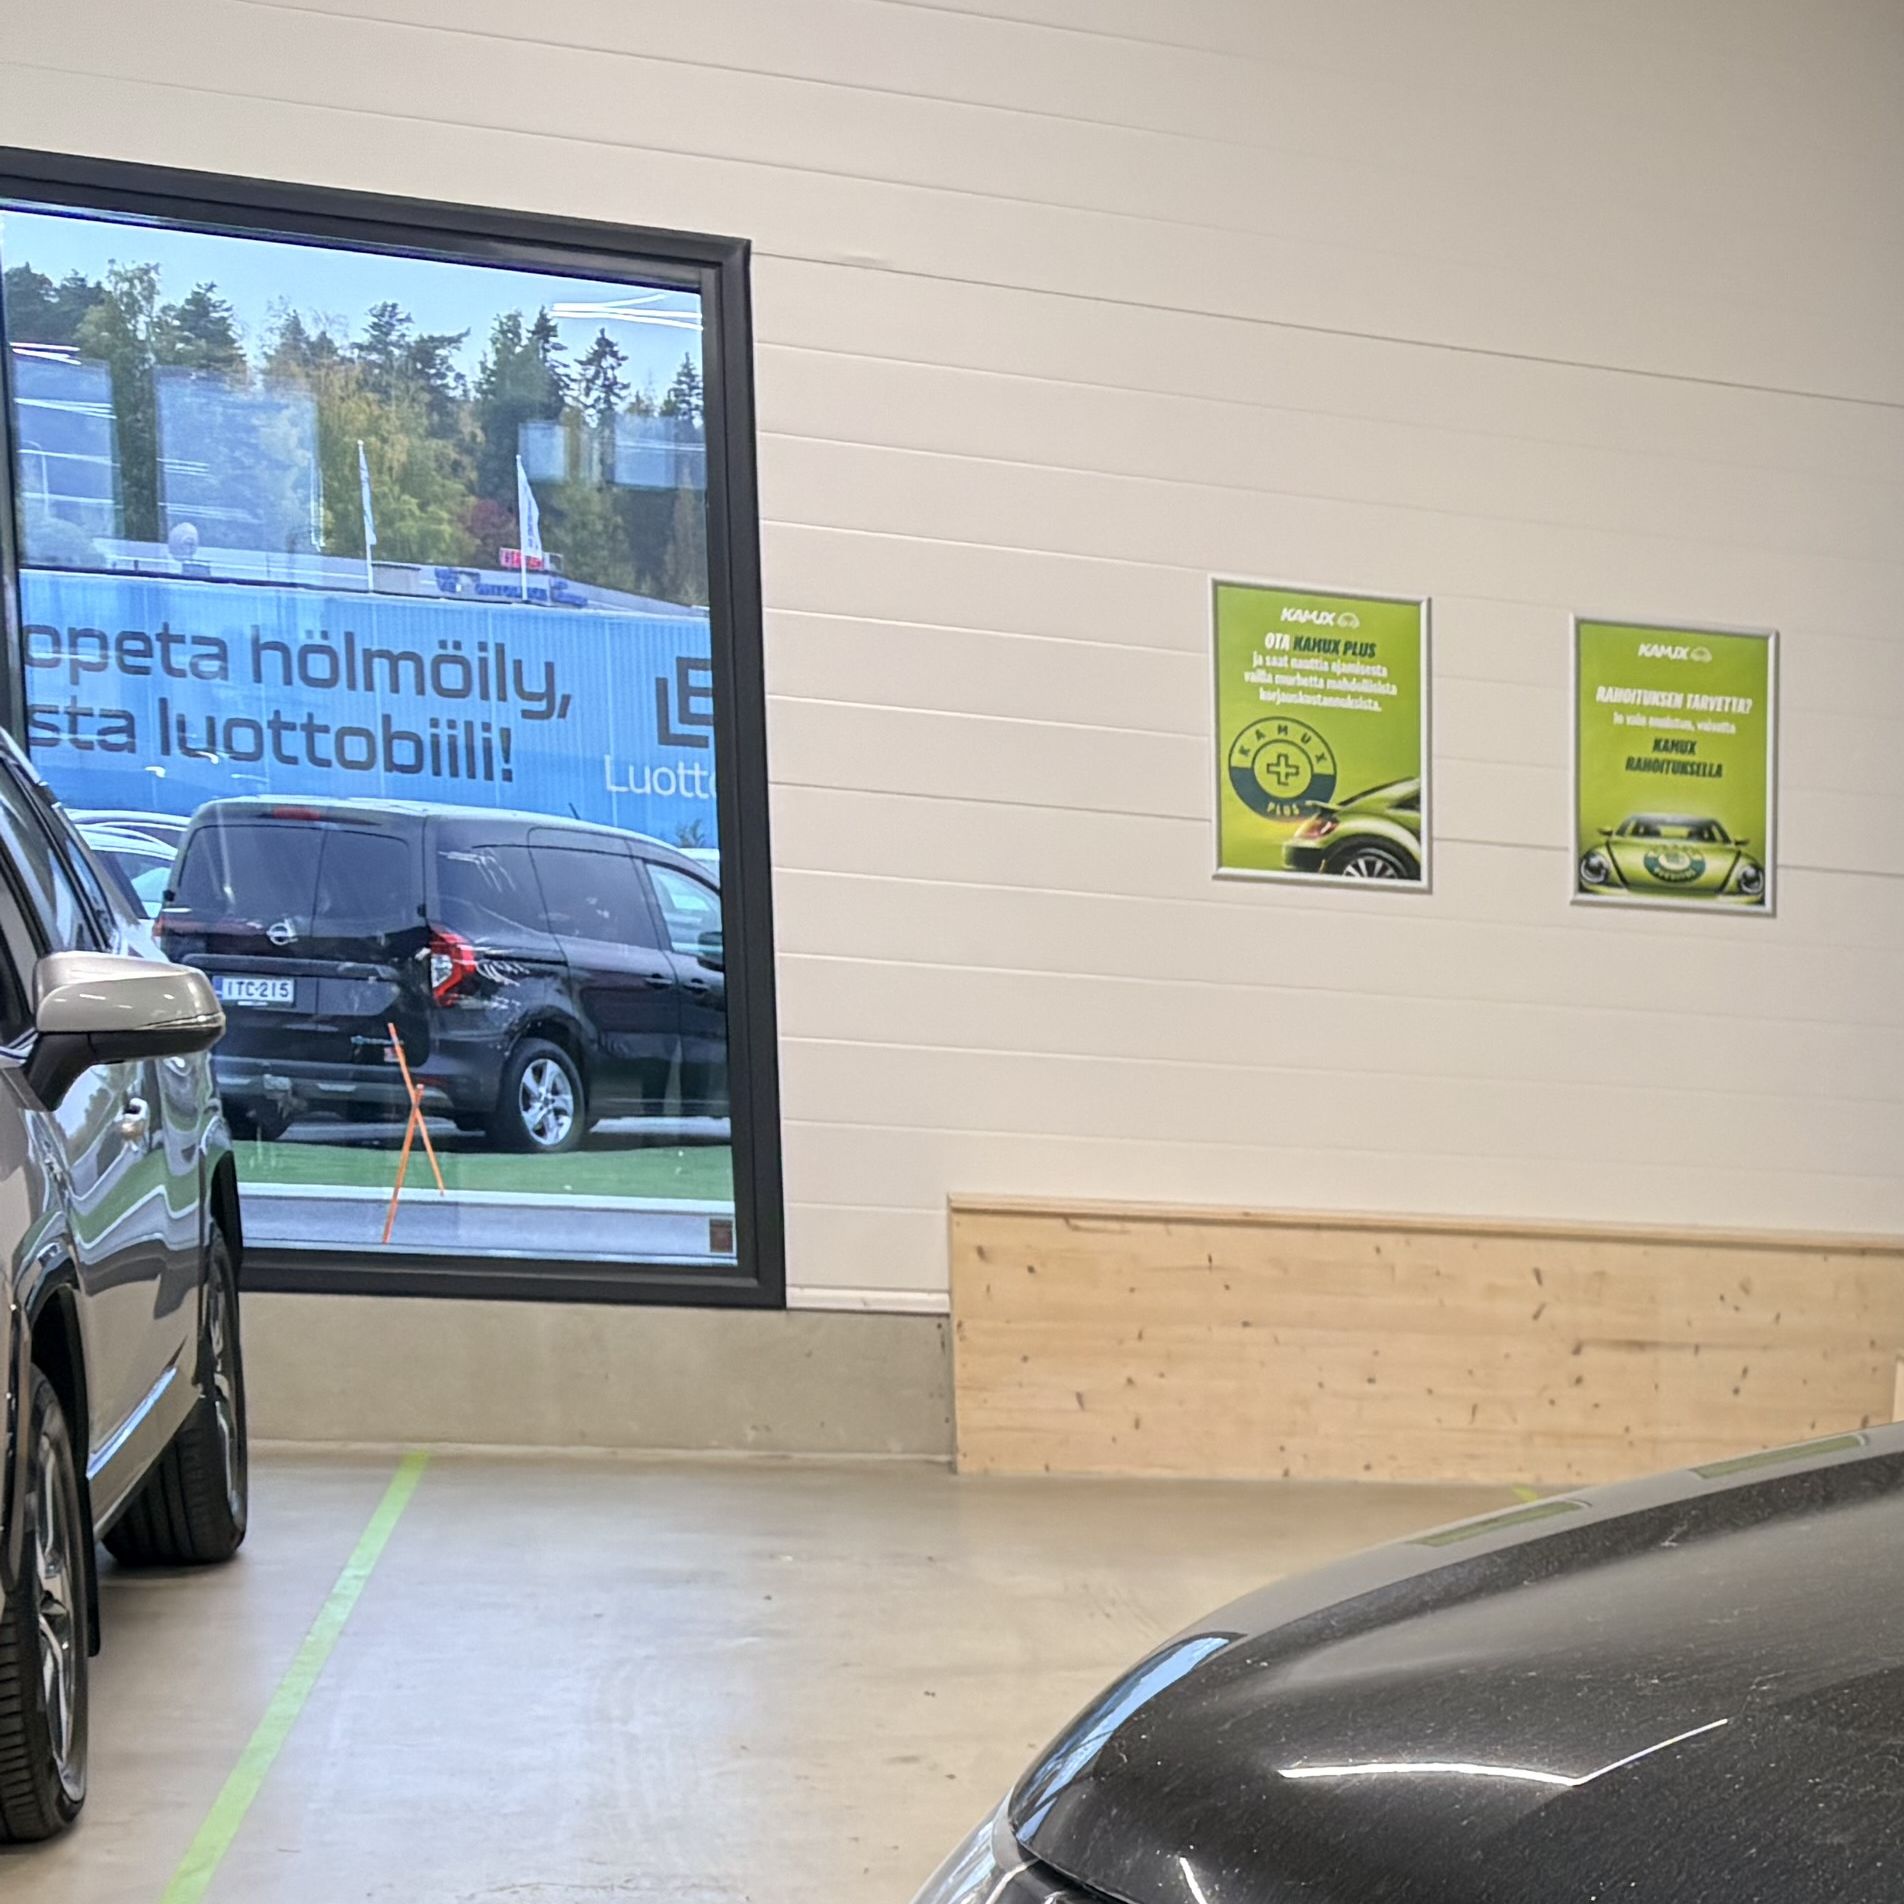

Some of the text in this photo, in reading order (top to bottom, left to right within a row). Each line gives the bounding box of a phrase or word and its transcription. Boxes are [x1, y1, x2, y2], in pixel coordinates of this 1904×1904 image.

[24, 621, 572, 720] opeta hölmöily,
[1264, 632, 1377, 658] OTA KAMUX PLUS
[29, 694, 514, 783] sta luottobiili!
[1652, 737, 1698, 756] KAMUX
